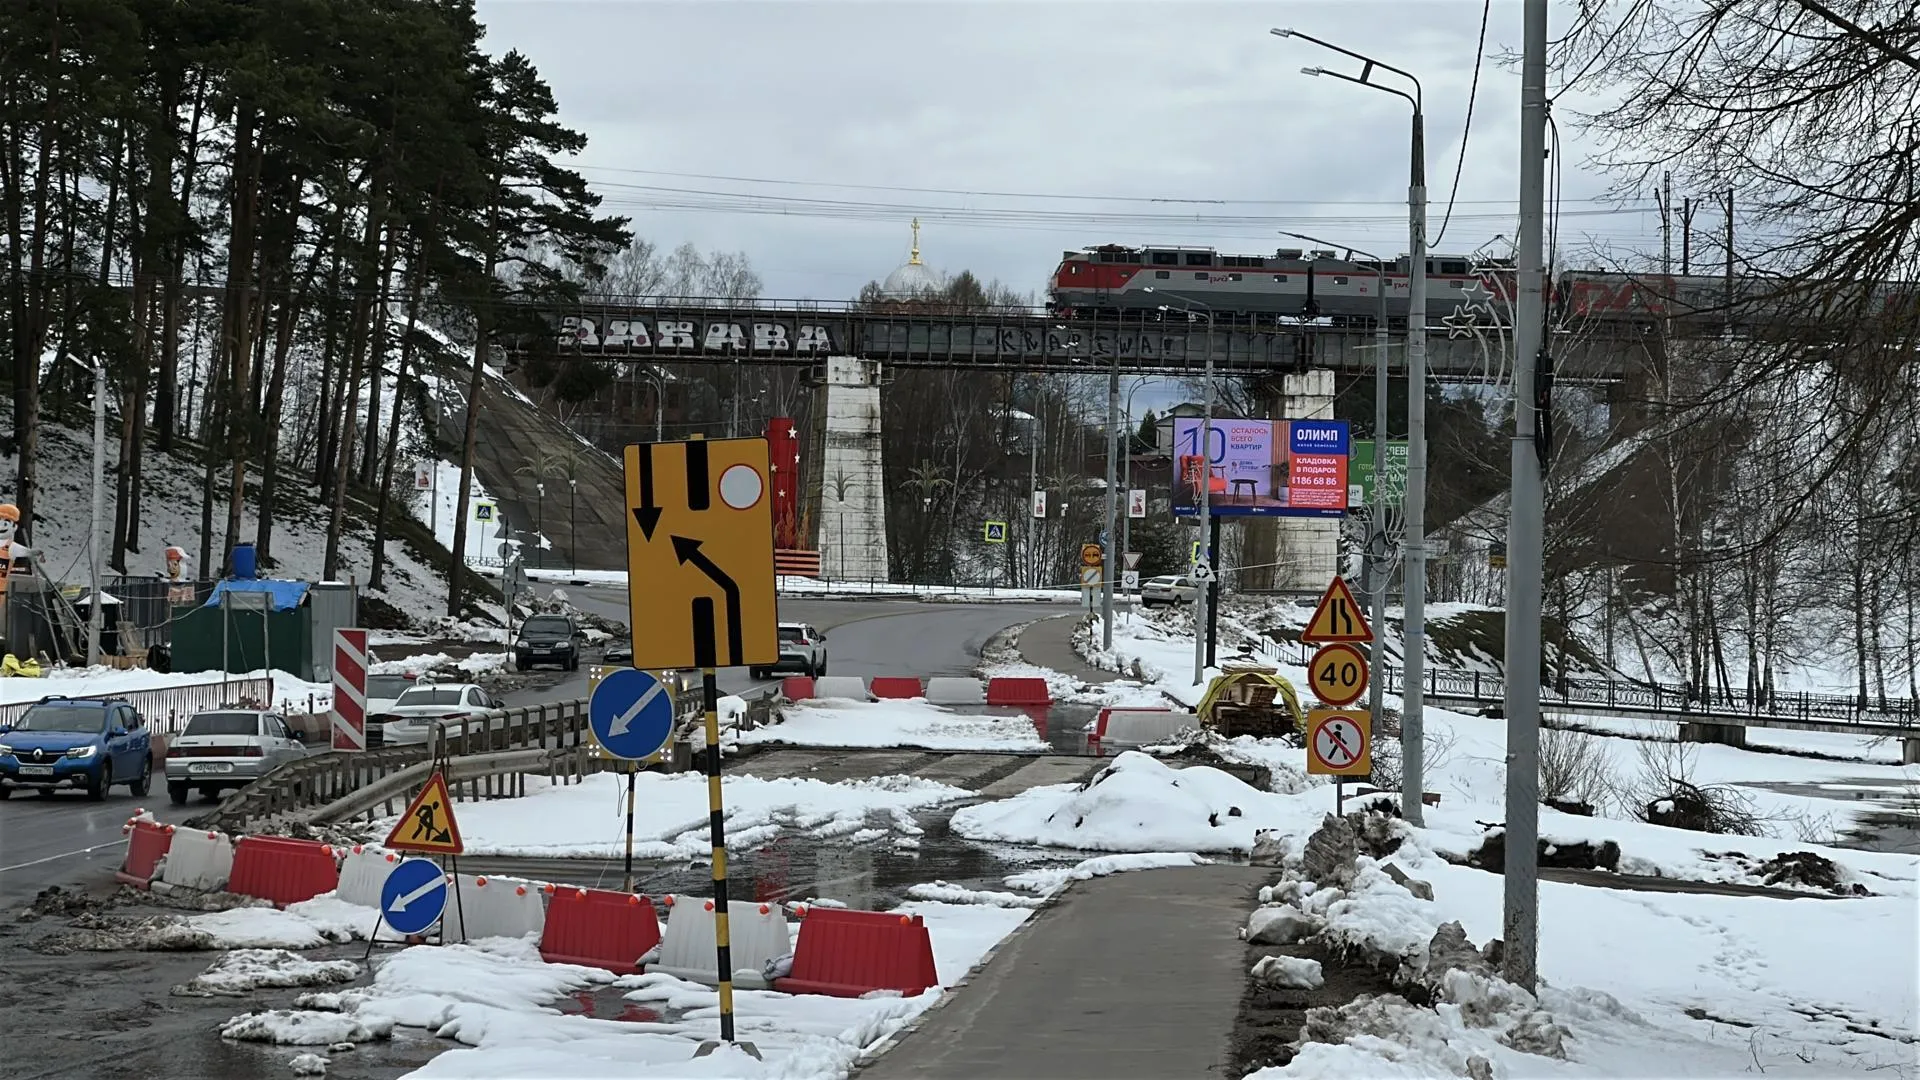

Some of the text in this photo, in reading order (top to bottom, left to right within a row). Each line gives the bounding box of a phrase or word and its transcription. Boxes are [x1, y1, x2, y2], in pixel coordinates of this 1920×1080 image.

[558, 316, 831, 351] ЗАБАВА
[1297, 429, 1337, 441] ОЛИМП
[1231, 443, 1262, 451] КВАРТИР
[1326, 478, 1337, 486] 86
[1320, 662, 1357, 687] 40
